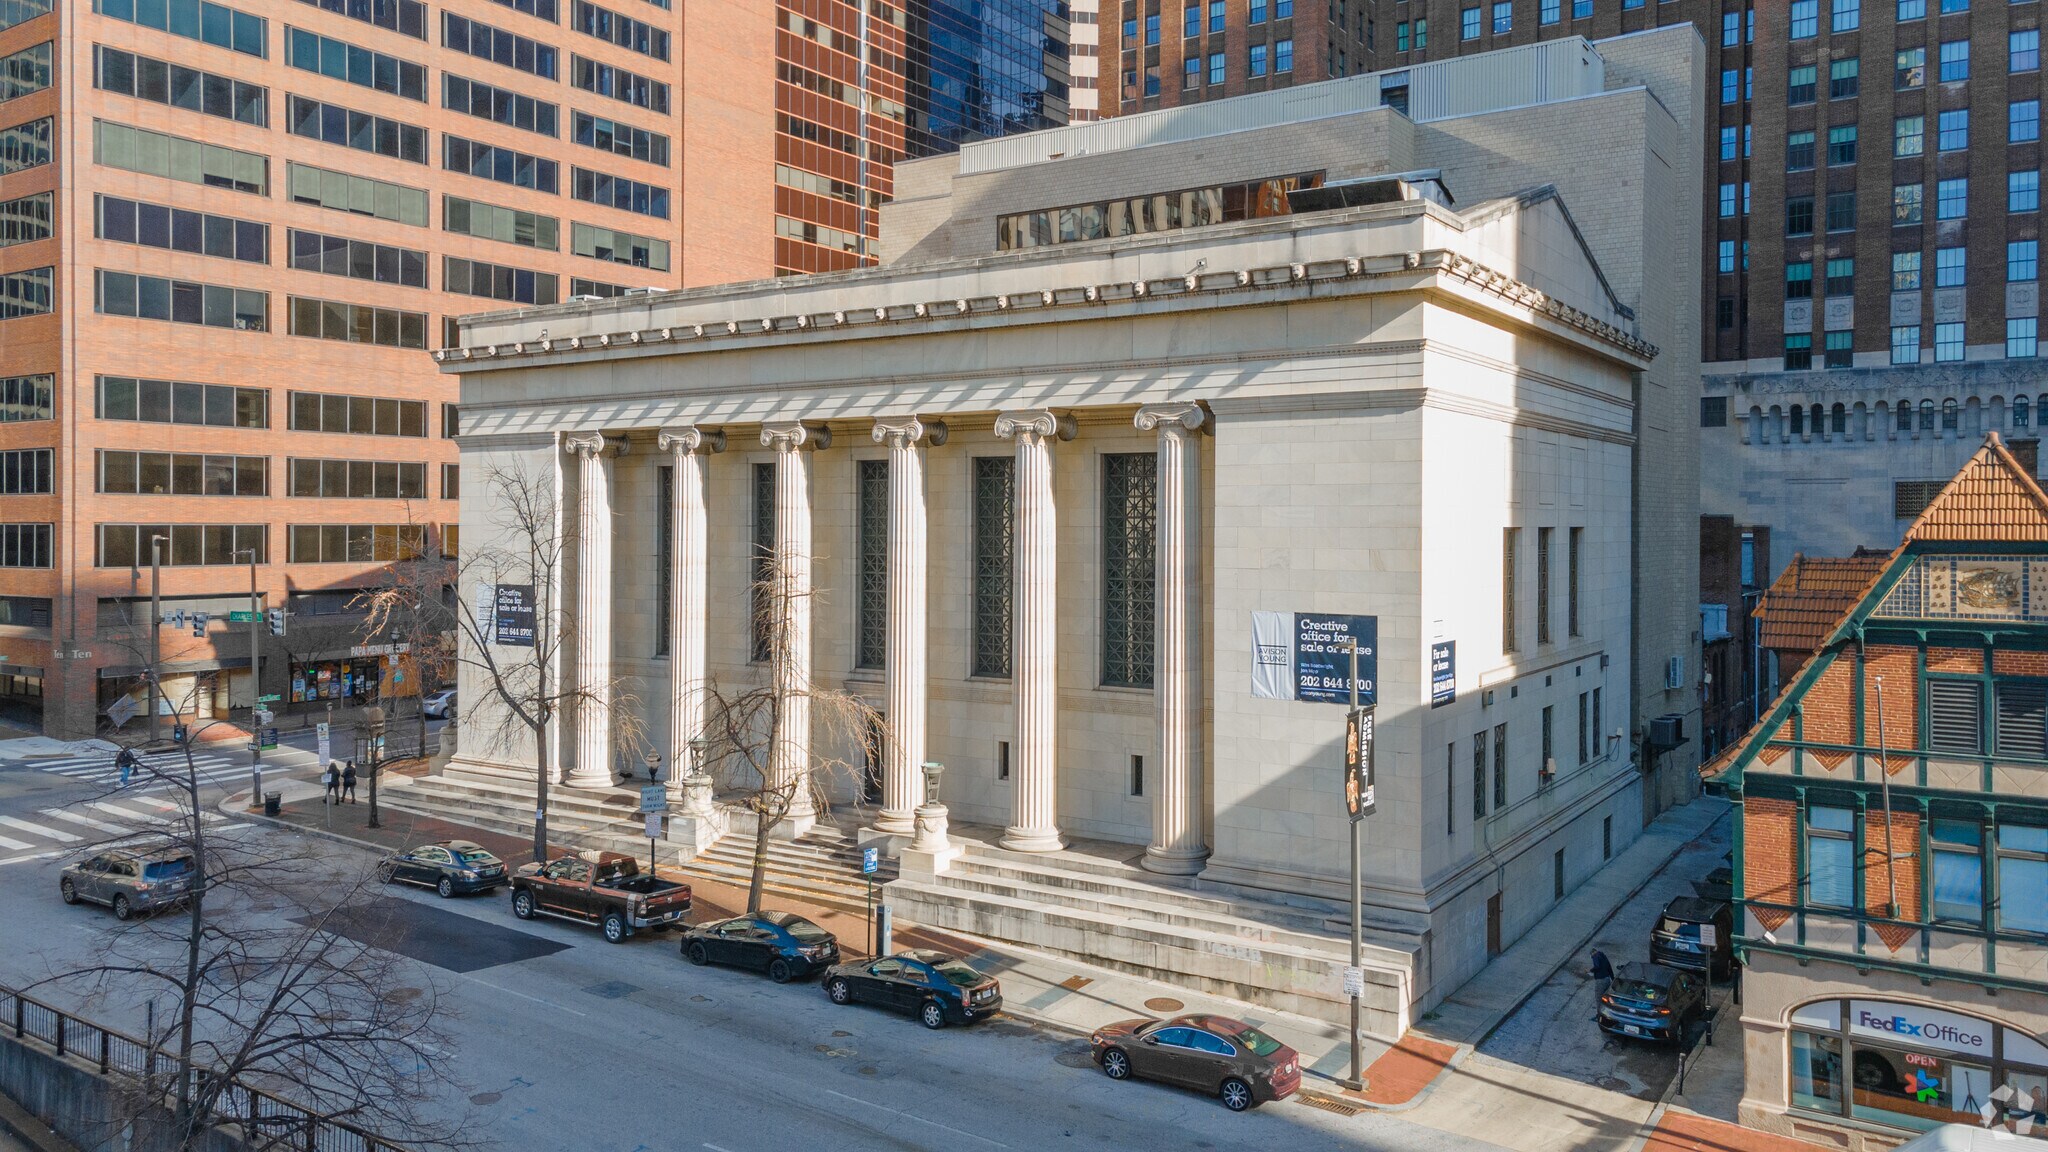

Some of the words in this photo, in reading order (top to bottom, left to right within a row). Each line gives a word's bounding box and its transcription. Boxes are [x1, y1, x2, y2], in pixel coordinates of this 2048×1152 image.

[1300, 619, 1348, 632] Creative
[1300, 630, 1331, 642] office
[1333, 632, 1350, 643] for
[53, 649, 64, 659] Ten
[71, 649, 92, 659] Ten
[1258, 646, 1287, 656] AVISON
[1300, 642, 1324, 653] sale
[1326, 645, 1338, 654] or
[1440, 647, 1449, 658] sale
[1258, 654, 1287, 663] YOUNG
[1300, 675, 1320, 687] 202
[1323, 676, 1343, 688] 644
[1860, 1010, 1921, 1036] FedEx
[1923, 1023, 1983, 1046] Office
[1905, 1053, 1937, 1067] OPEN
